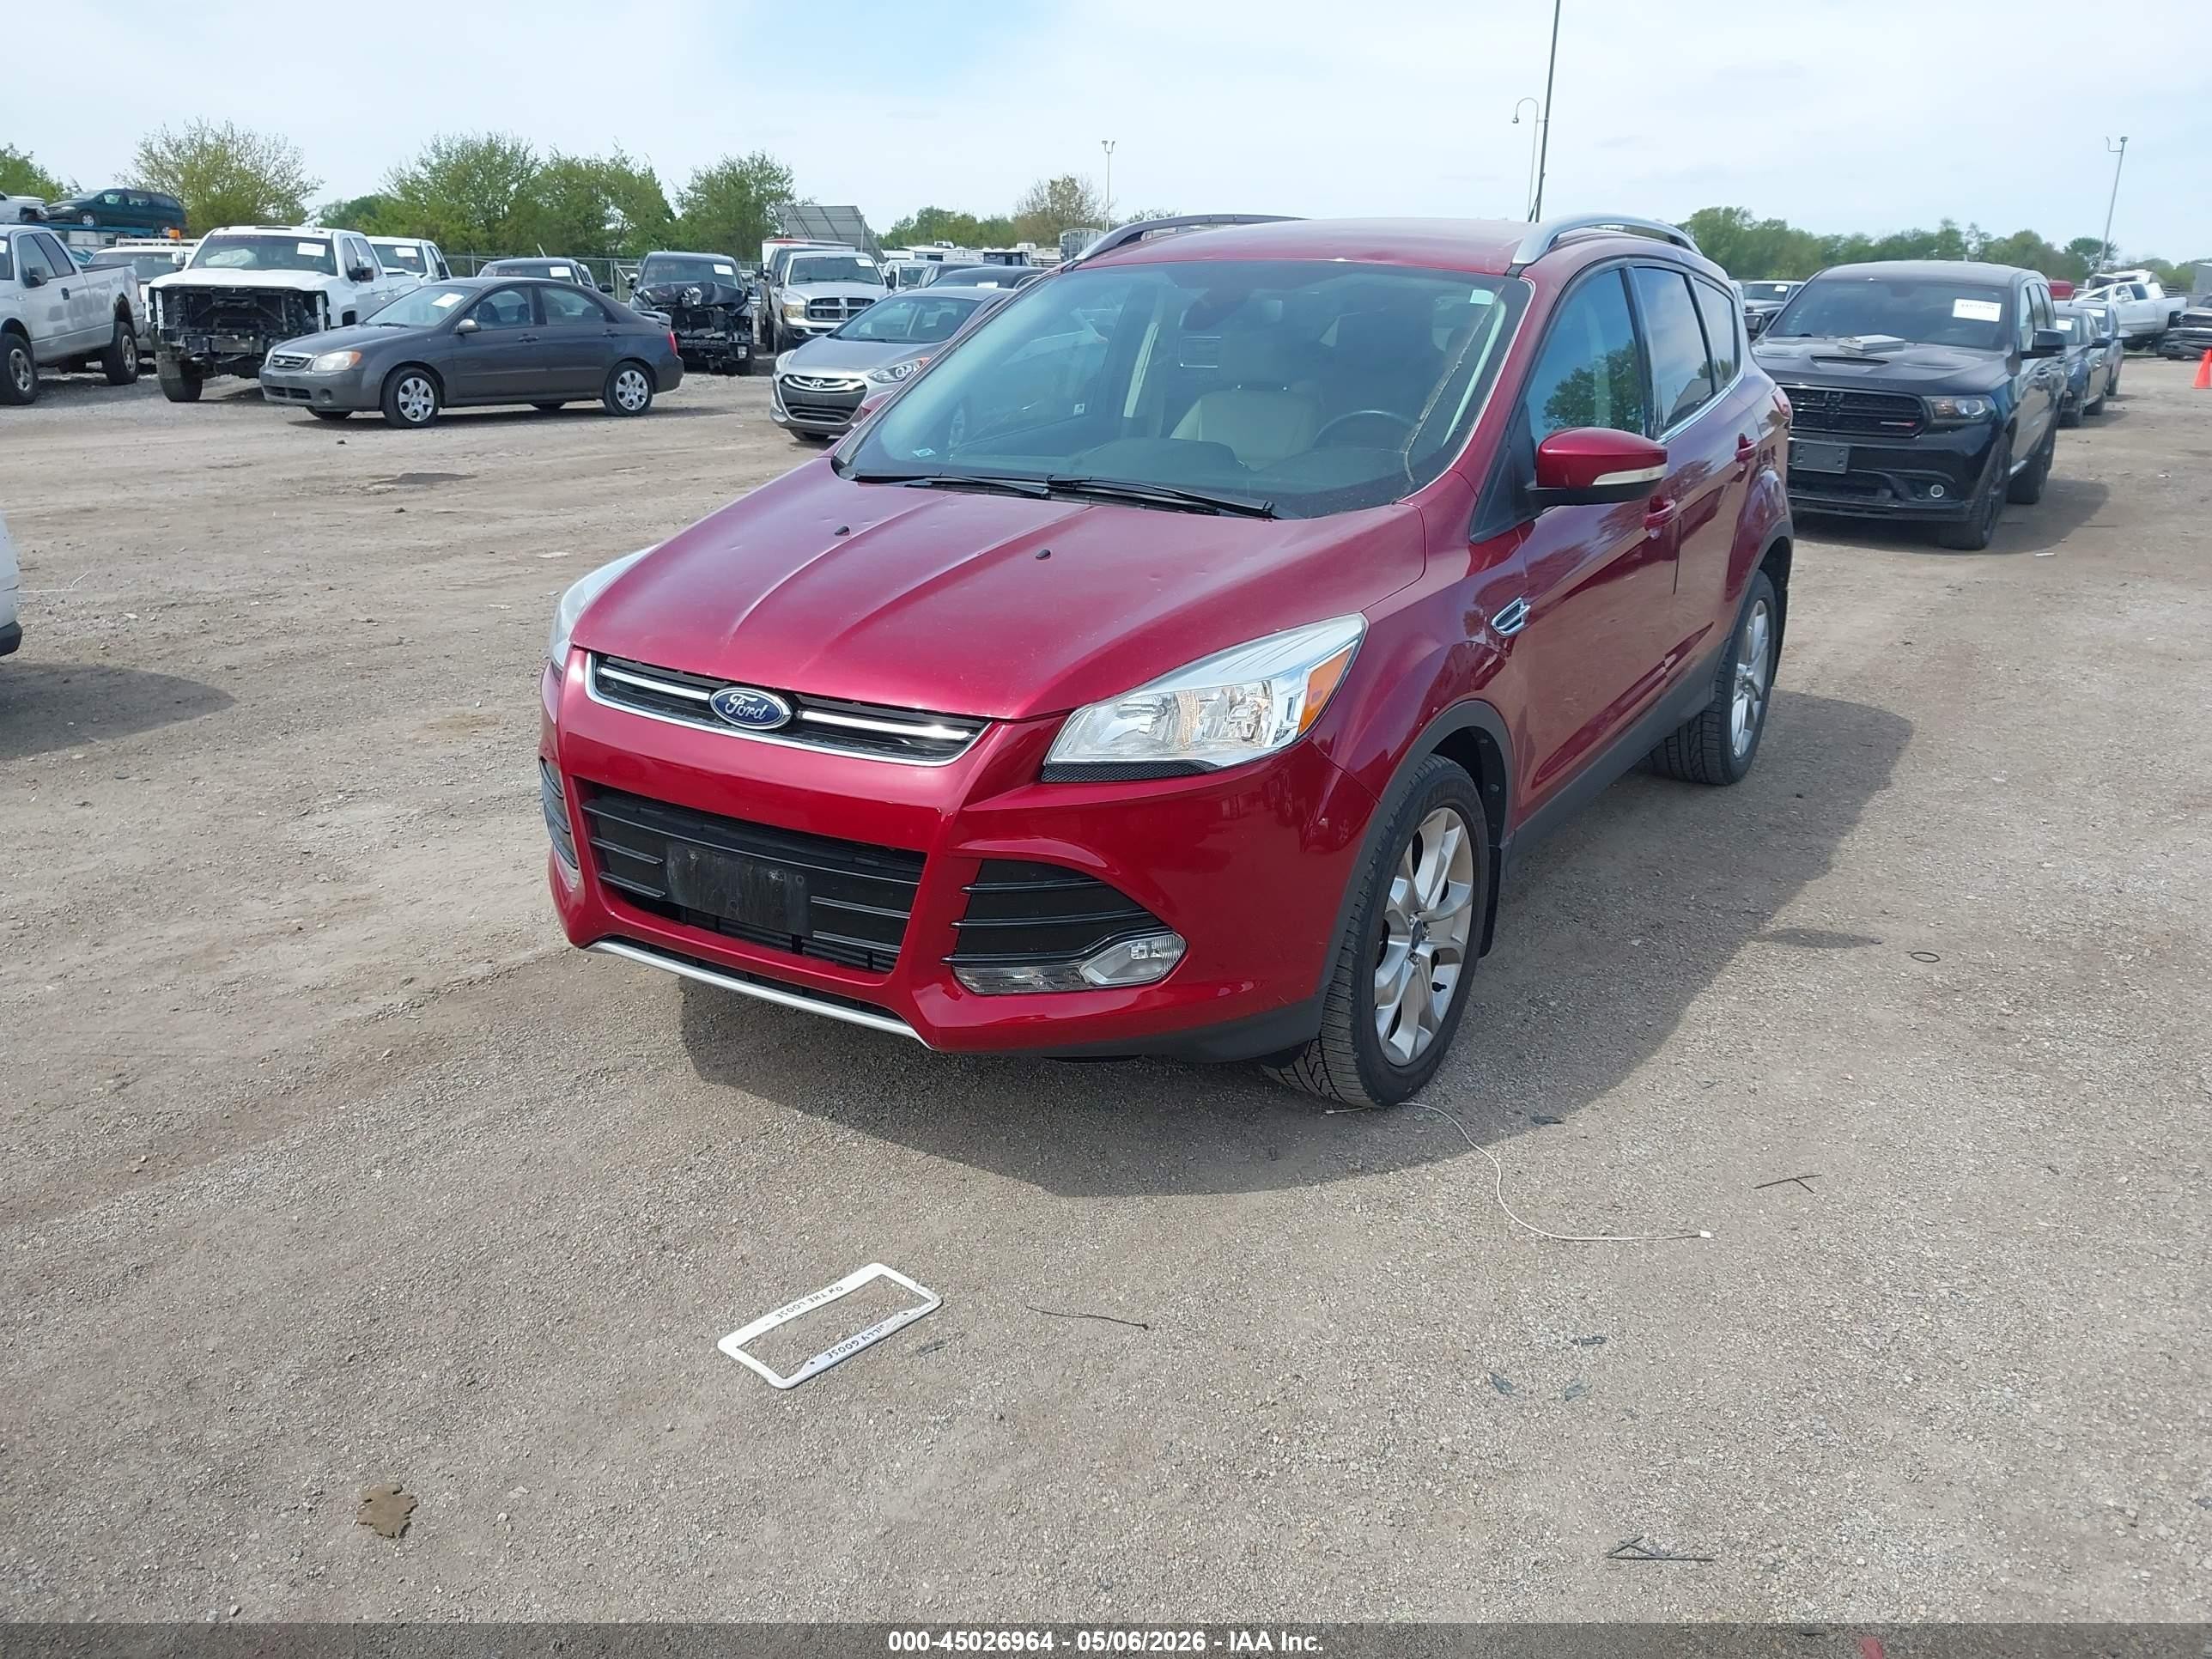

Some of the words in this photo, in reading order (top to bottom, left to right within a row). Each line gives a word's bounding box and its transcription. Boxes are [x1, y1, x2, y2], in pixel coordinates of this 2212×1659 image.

[725, 693, 769, 720] Ford
[807, 1292, 828, 1304] THE
[775, 1301, 806, 1319] LOOSE
[825, 1340, 860, 1359] GOOSE
